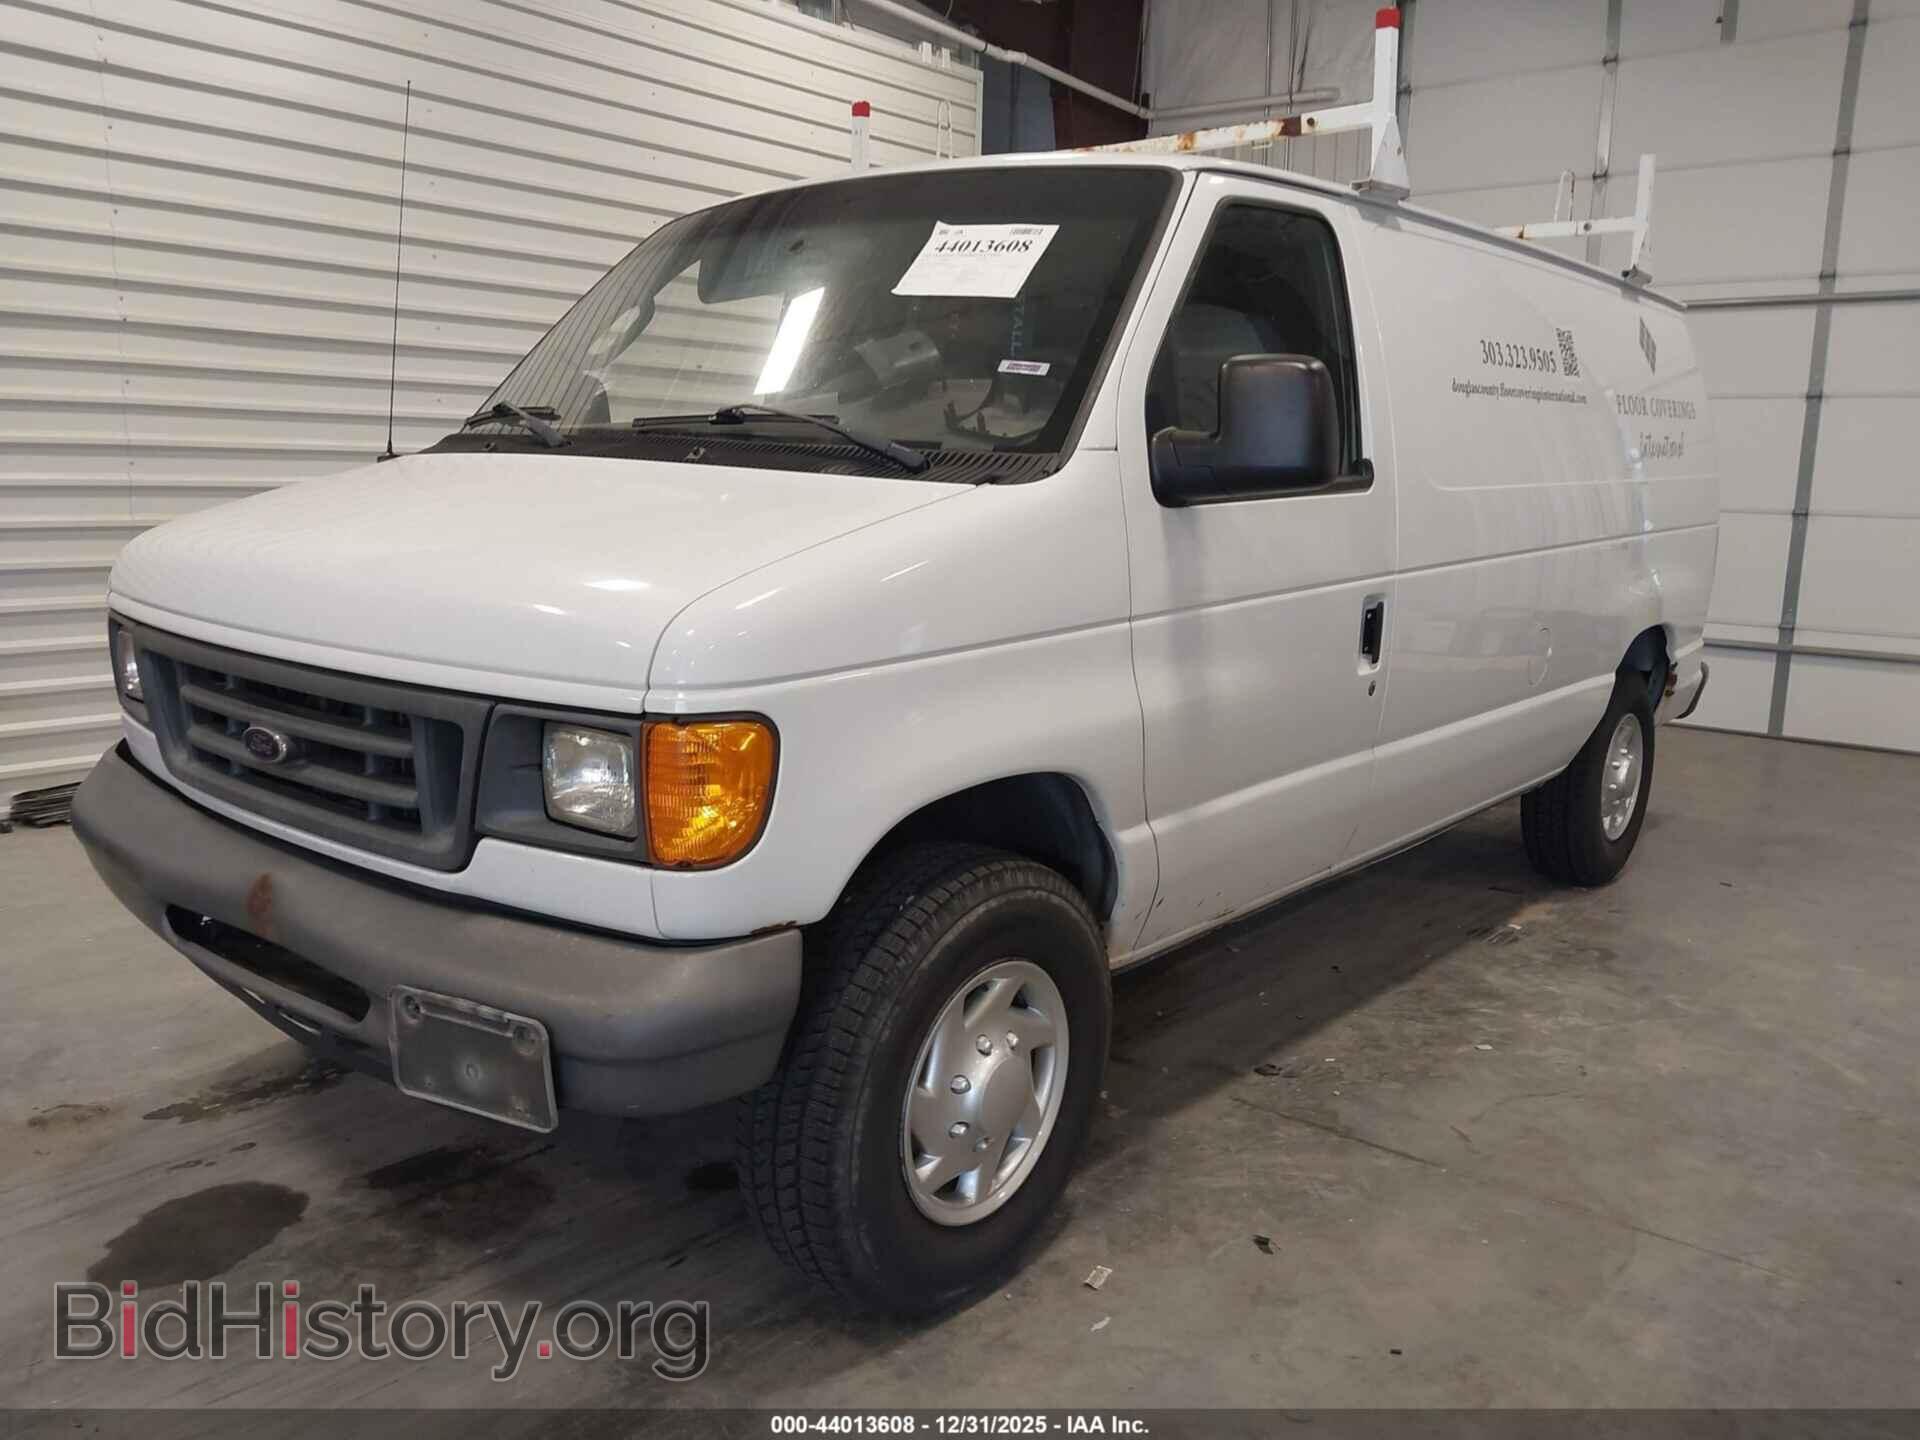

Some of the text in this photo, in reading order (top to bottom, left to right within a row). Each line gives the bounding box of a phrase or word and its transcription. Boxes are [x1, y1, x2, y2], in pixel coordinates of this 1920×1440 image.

[935, 239, 1033, 253] 44013608
[1480, 339, 1557, 374] 303.323.9505
[1616, 394, 1696, 420] FLOOR COVERINGS
